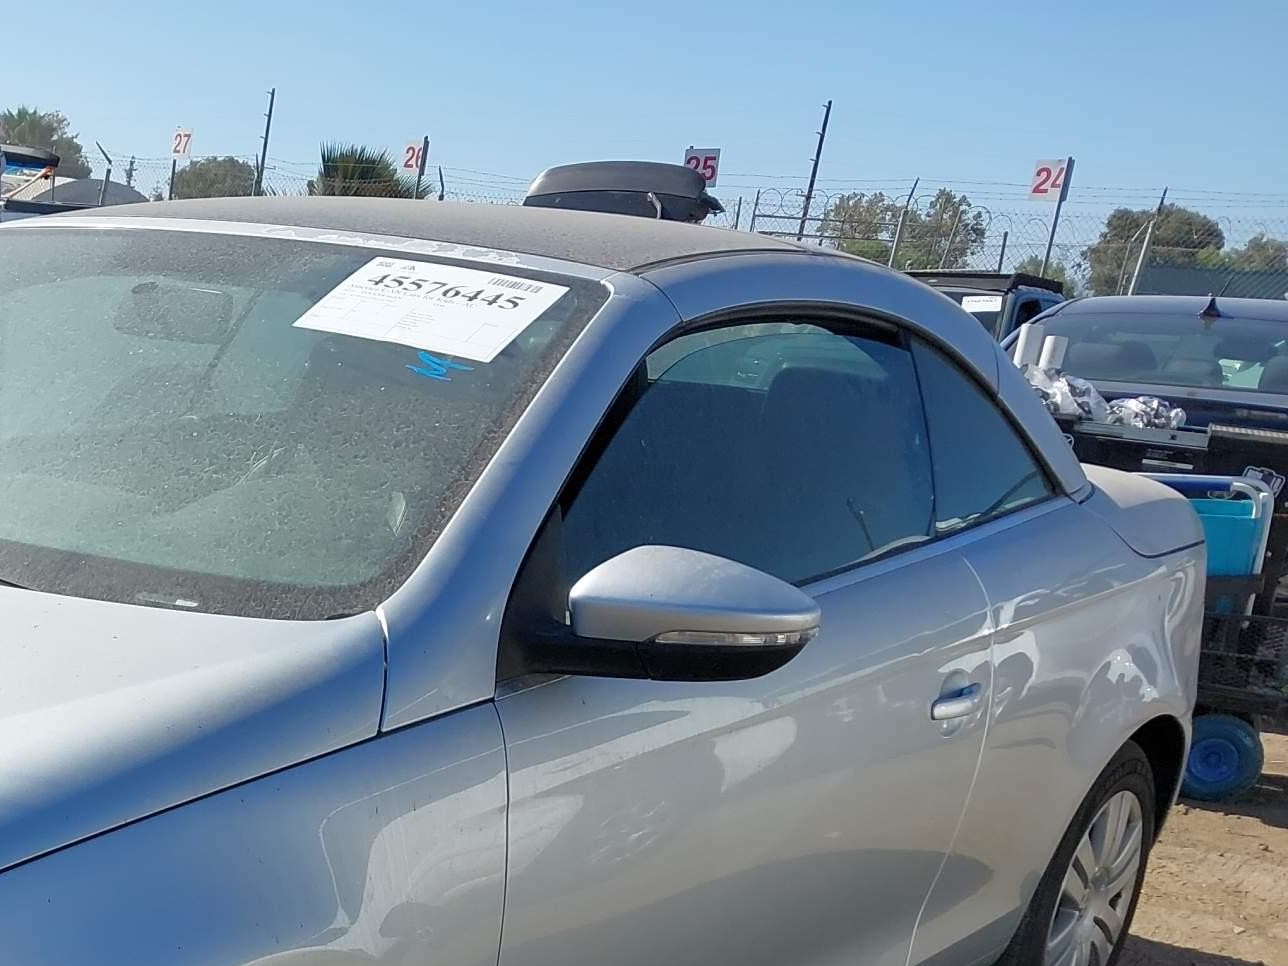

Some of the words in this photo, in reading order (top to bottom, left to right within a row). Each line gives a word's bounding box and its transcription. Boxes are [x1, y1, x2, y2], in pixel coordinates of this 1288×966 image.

[173, 133, 192, 153] 27
[686, 155, 717, 180] 25
[367, 273, 526, 310] 45576445
